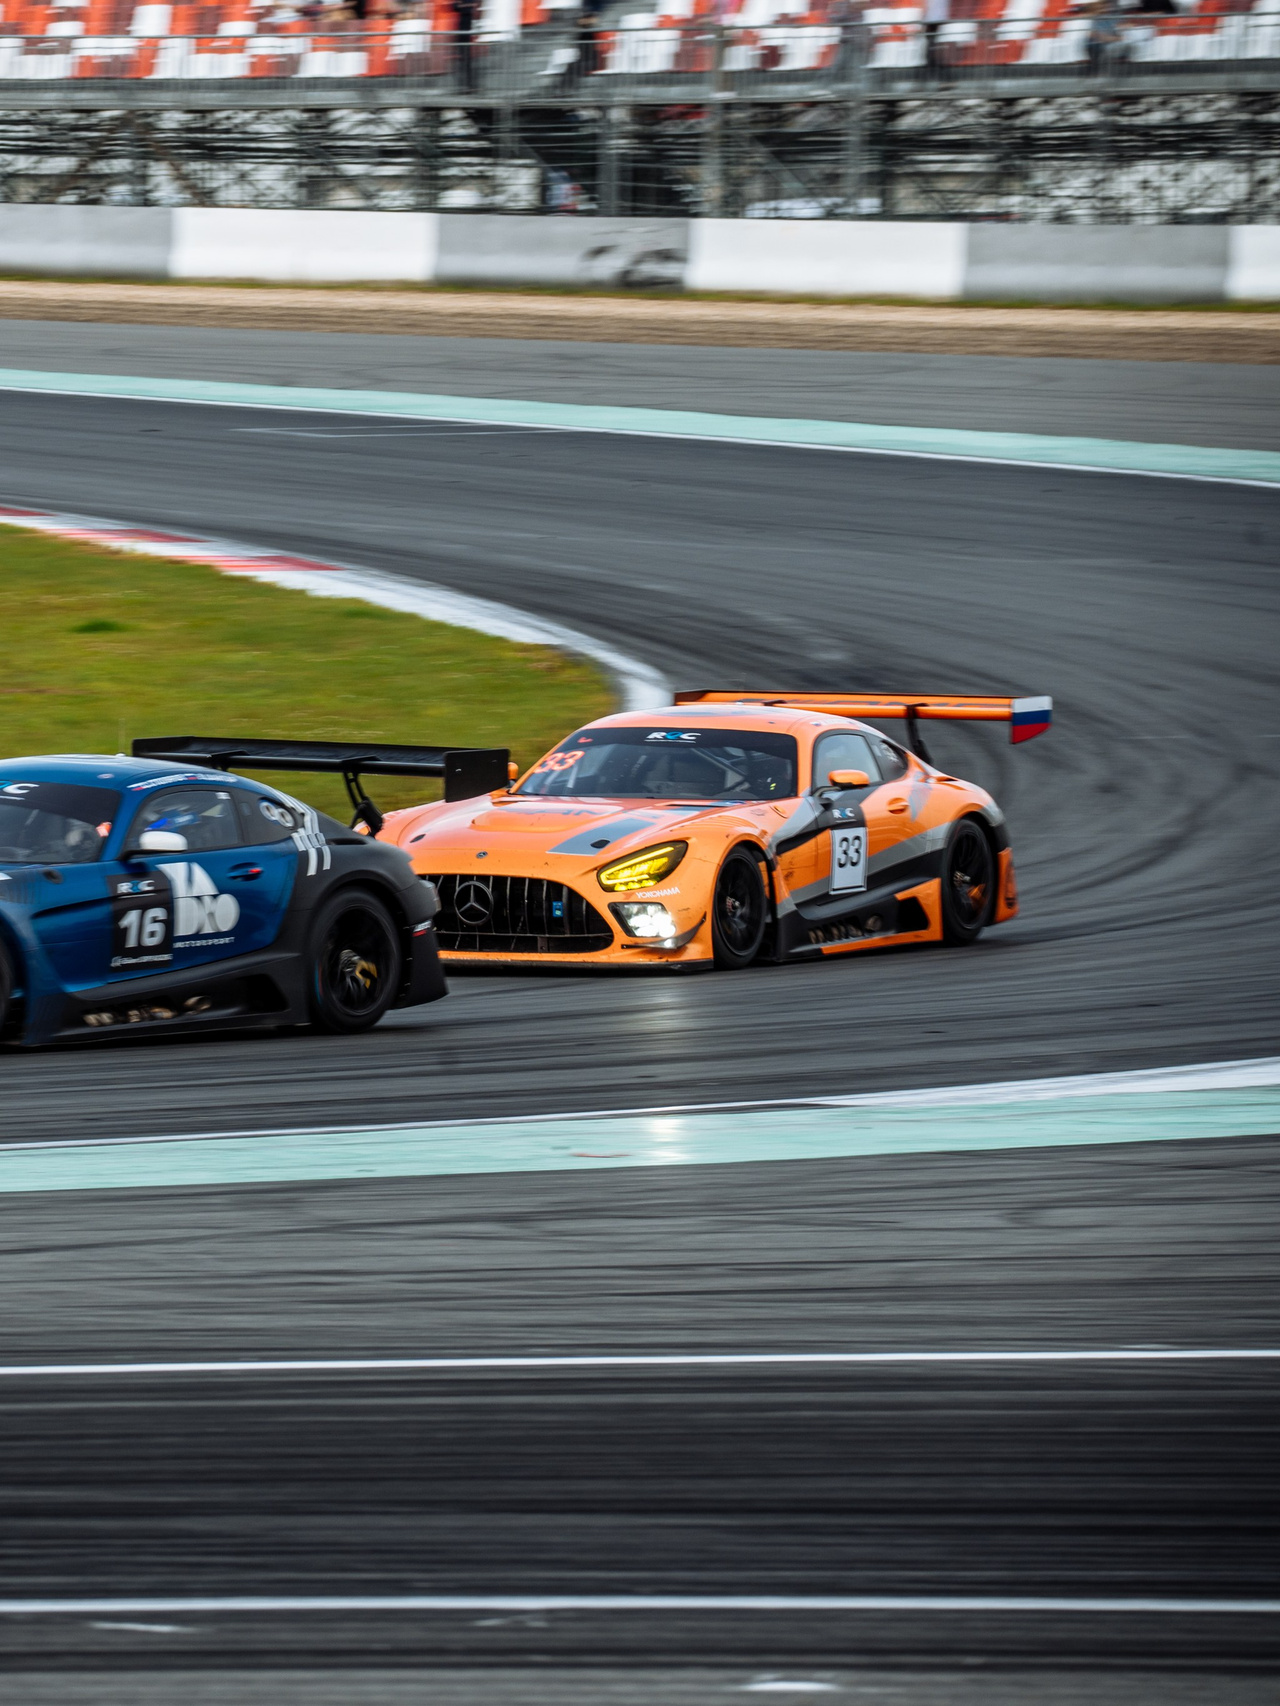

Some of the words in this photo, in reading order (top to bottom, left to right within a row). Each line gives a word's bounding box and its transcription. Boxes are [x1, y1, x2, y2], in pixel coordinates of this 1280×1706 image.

[534, 750, 585, 774] 33
[837, 835, 862, 868] 33
[635, 886, 681, 899] YOKOHAMA
[118, 907, 168, 948] 16
